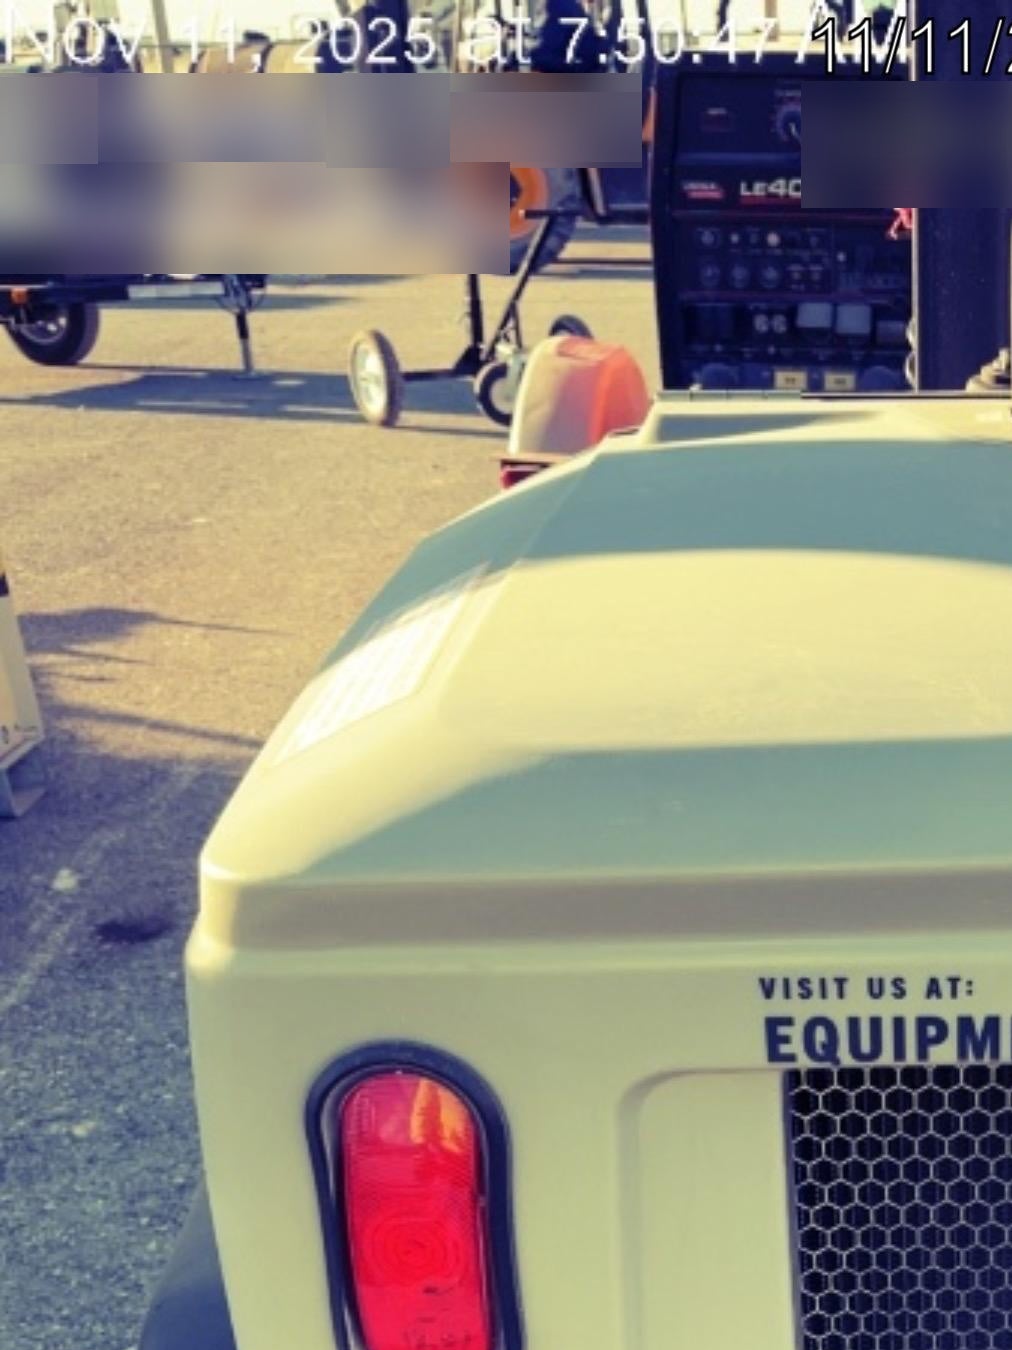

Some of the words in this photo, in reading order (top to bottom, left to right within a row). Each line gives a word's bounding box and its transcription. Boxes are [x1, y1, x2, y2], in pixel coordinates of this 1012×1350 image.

[758, 976, 850, 1000] VISIT
[866, 977, 908, 999] US
[924, 976, 976, 999] AT:
